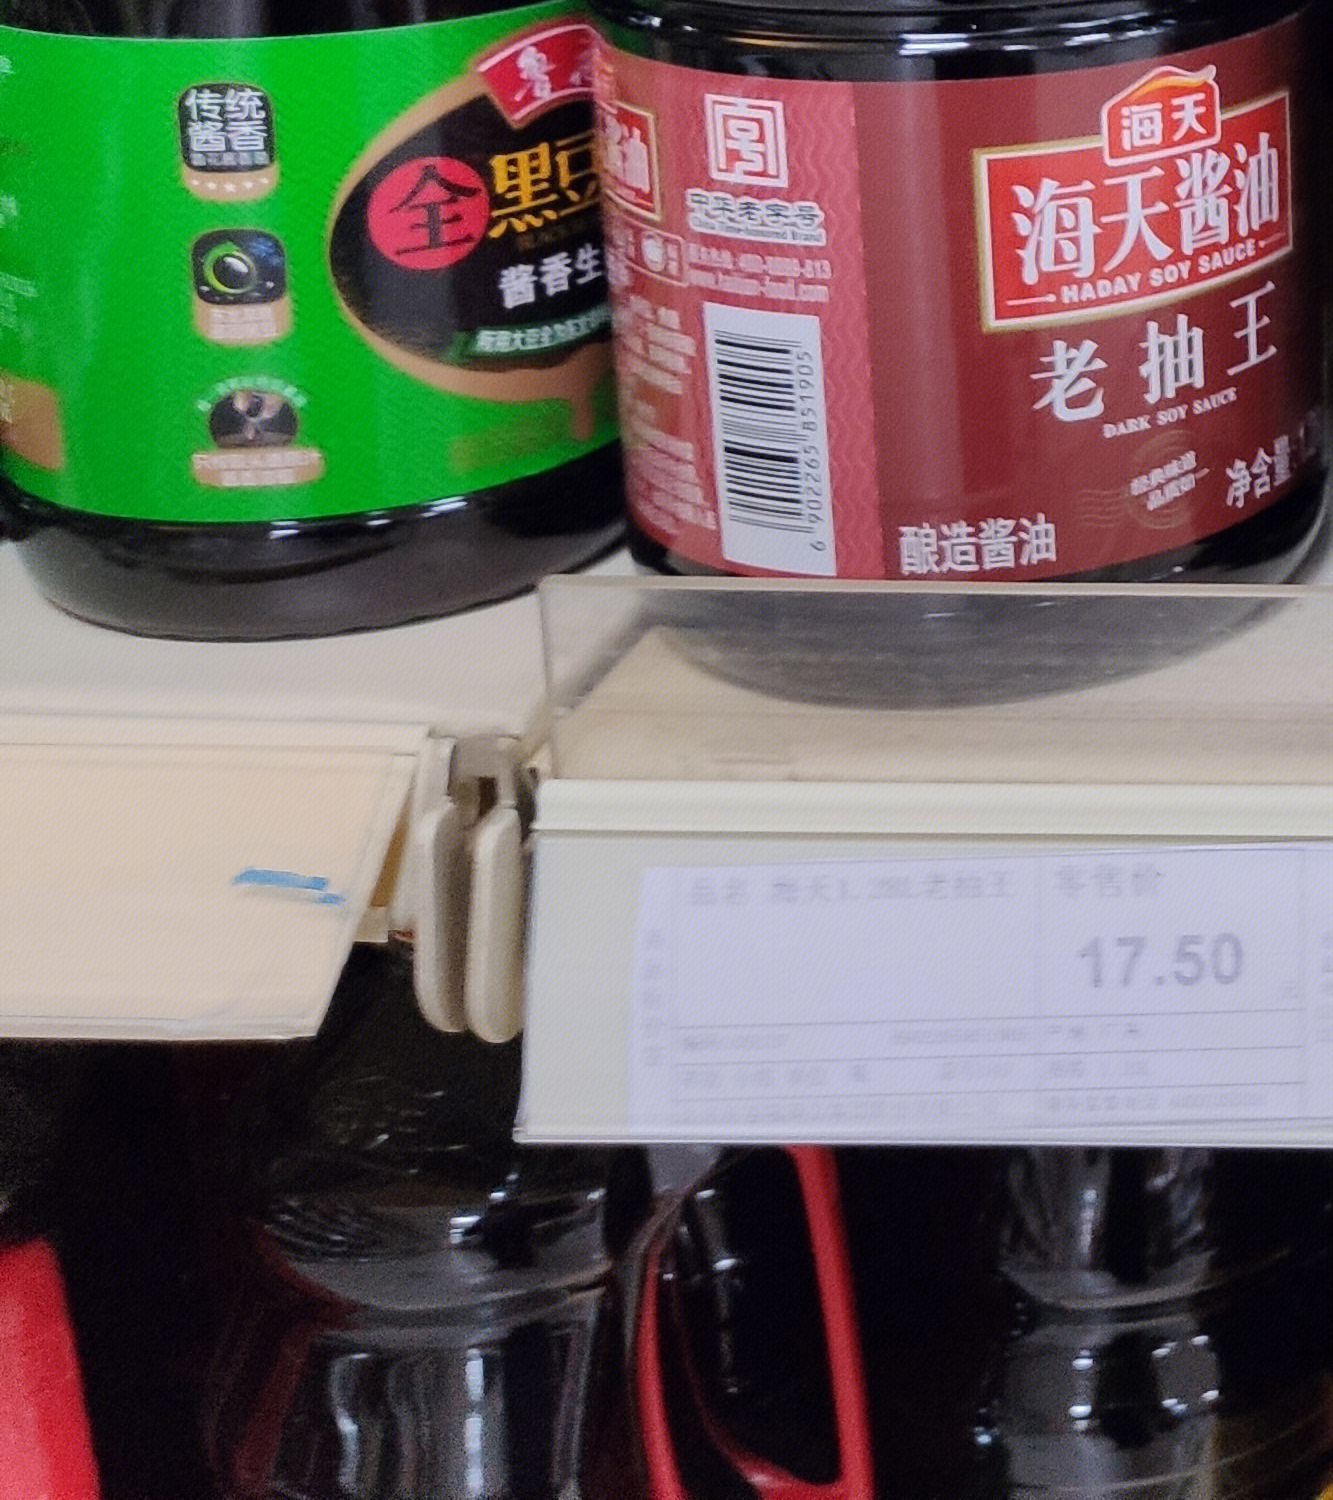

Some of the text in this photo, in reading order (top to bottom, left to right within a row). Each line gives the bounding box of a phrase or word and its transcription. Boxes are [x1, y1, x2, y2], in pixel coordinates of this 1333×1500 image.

[184, 87, 267, 121] 传统
[1120, 91, 1209, 148] 海天
[187, 120, 269, 152] 酱香
[387, 164, 478, 257] 全
[1012, 130, 1281, 288] 海天酱油
[1060, 242, 1258, 306] HADAY SOY SAUCE
[1029, 280, 1279, 424] 老抽王
[1102, 414, 1152, 440] DARK
[1156, 404, 1189, 427] SOY
[811, 539, 828, 552] 6
[900, 512, 1058, 576] 酿造酱油
[1075, 931, 1244, 989] 17.50
